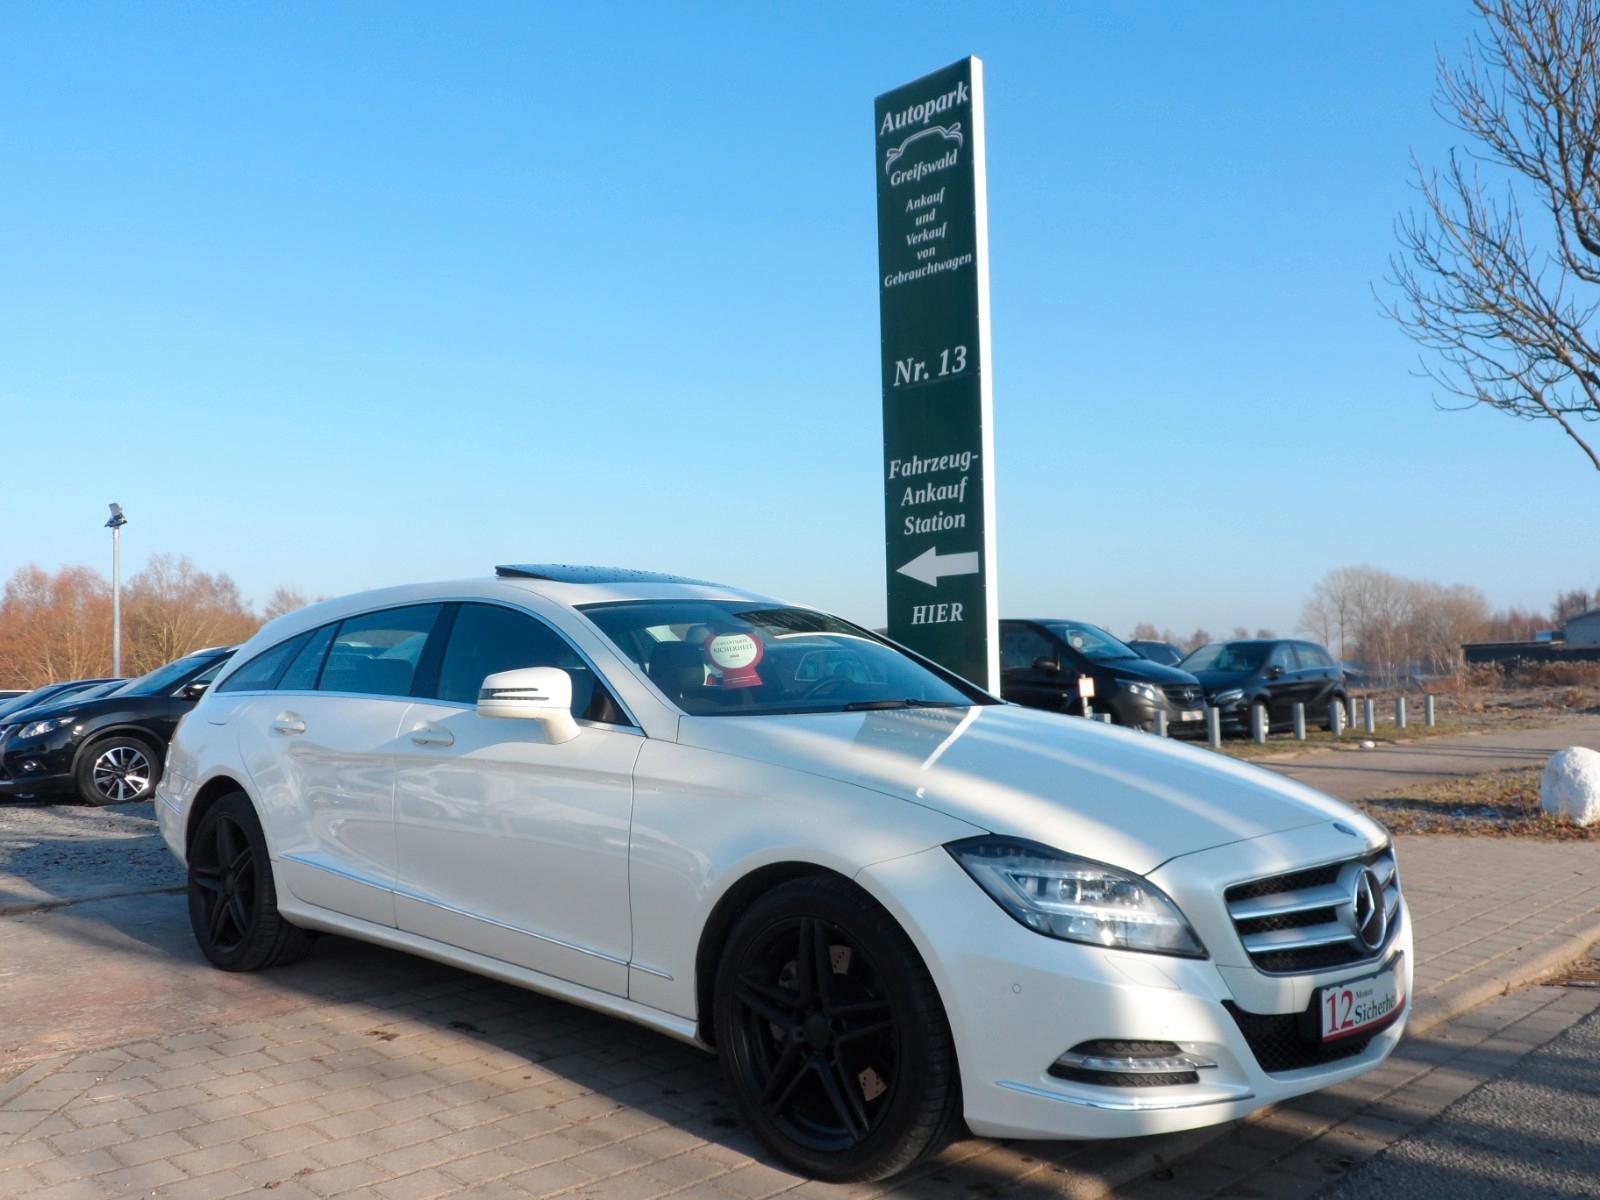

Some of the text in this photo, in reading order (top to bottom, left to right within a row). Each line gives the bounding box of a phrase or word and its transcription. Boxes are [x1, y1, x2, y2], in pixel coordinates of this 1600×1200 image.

[880, 81, 969, 135] Autopark
[890, 148, 958, 186] Greifswald
[905, 186, 945, 213] Ankauf
[915, 208, 936, 226] und
[906, 222, 947, 246] Verkauf
[917, 246, 936, 260] von
[884, 253, 972, 287] Gebrauchtwagen
[893, 345, 967, 387] Nr. 13
[888, 451, 979, 480] Fahrzeug-
[901, 476, 968, 506] Ankauf
[904, 511, 966, 536] Station
[911, 603, 963, 625] HIER
[1326, 990, 1355, 1034] 12
